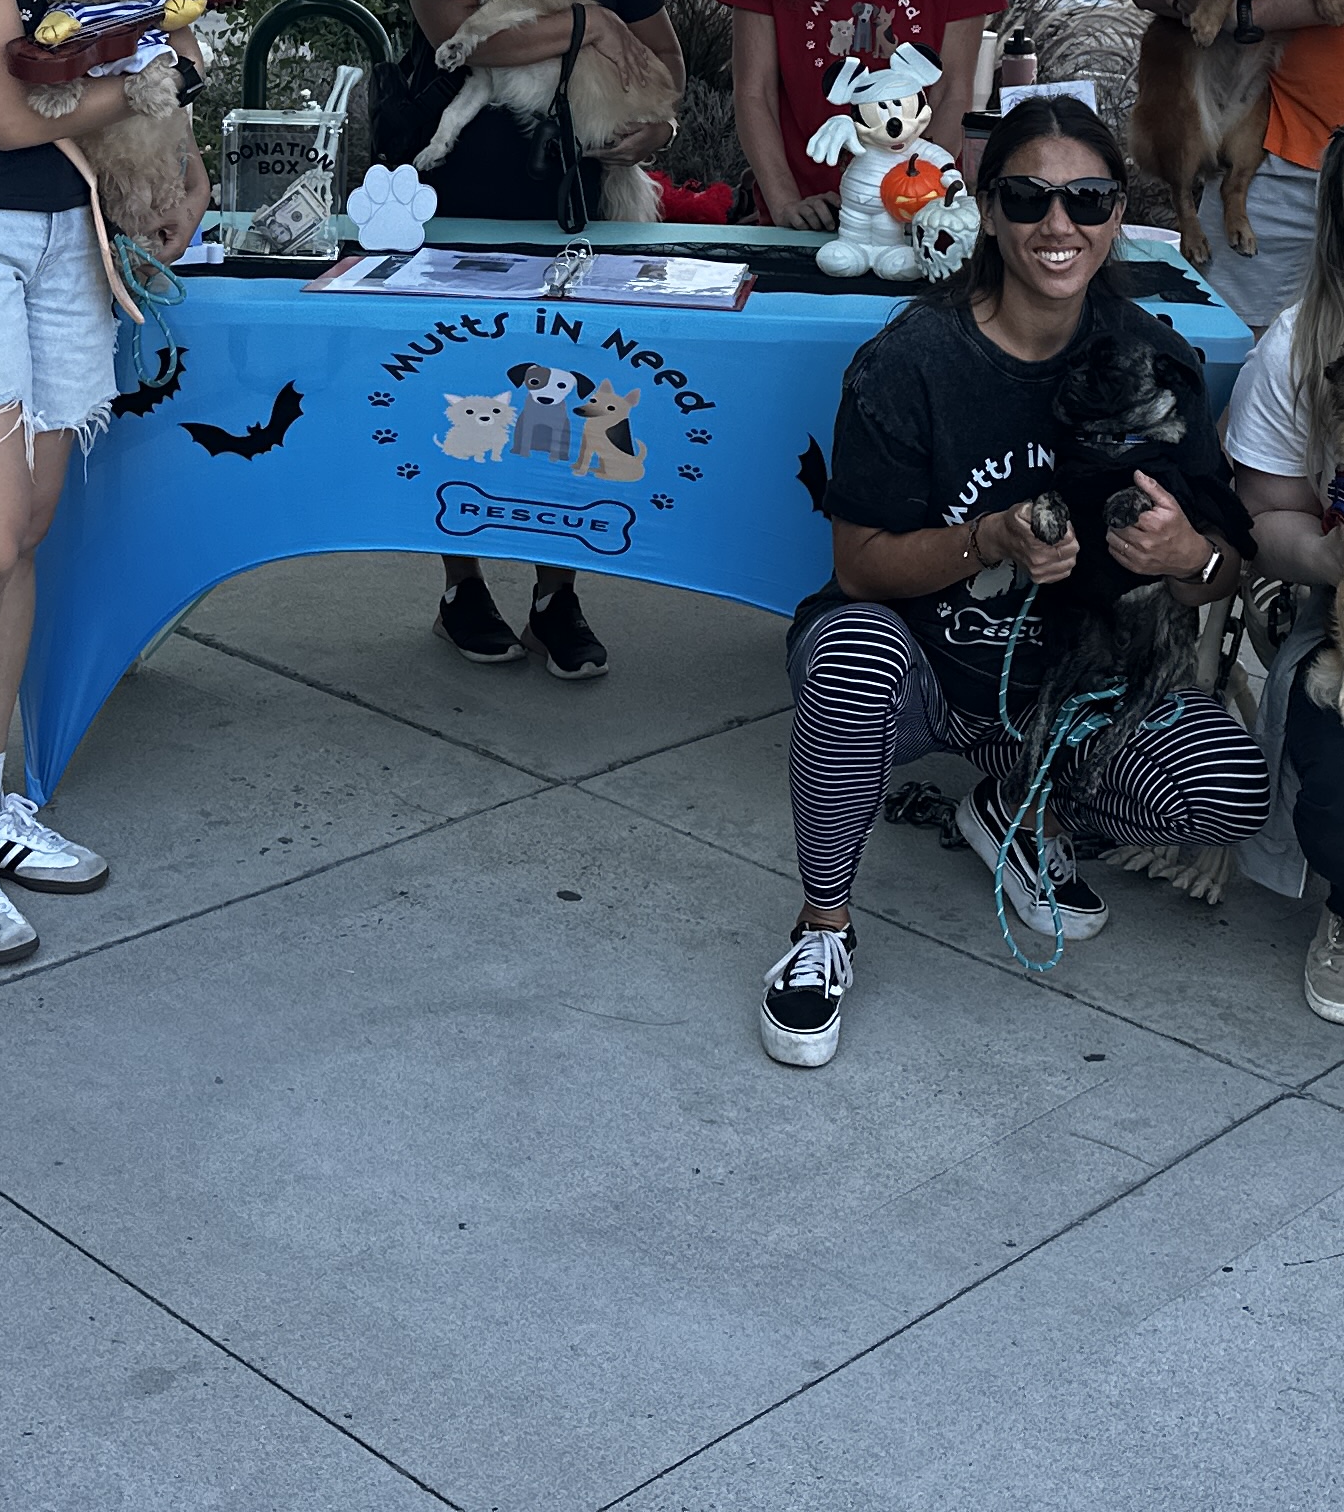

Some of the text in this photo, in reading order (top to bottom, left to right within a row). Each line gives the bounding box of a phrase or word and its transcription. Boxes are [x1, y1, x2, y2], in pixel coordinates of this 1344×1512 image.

[226, 142, 334, 171] DONATION
[258, 159, 299, 175] BOX
[380, 311, 509, 382] Mutts
[600, 328, 717, 416] Need
[459, 501, 610, 534] RESCUE
